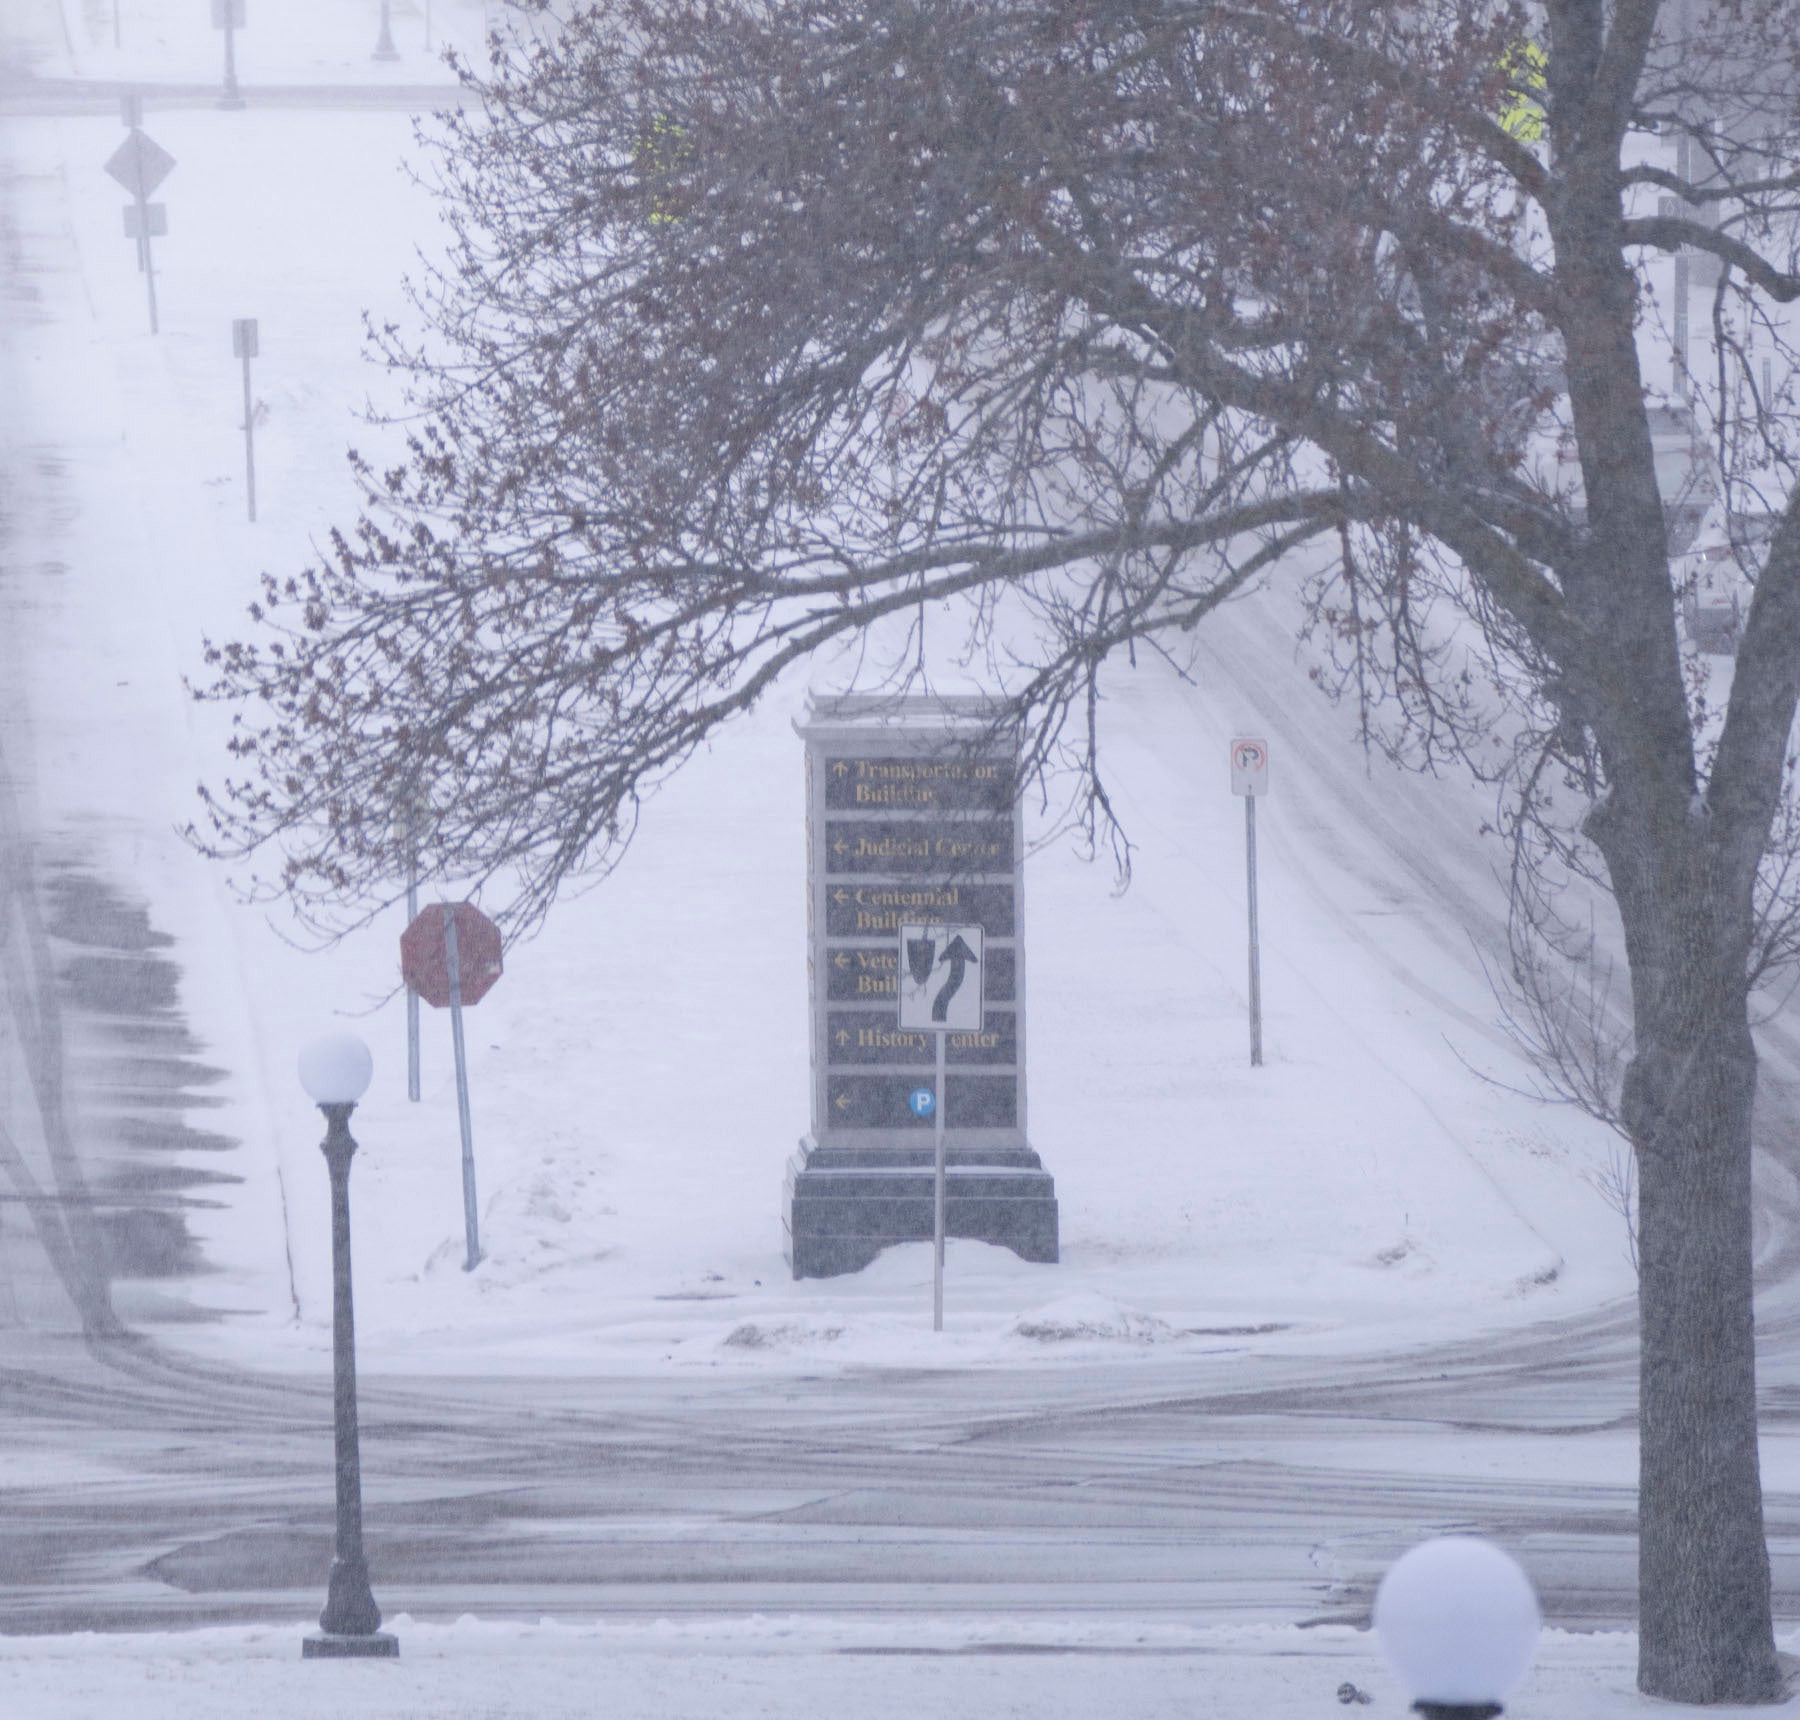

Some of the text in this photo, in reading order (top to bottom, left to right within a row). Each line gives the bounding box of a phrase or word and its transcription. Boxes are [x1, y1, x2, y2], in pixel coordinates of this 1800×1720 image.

[855, 760, 999, 782] Transportaon
[856, 783, 940, 803] Buildin
[855, 837, 1000, 856] Judicial Cener
[855, 887, 959, 905] Centennial
[856, 951, 897, 969] Vete
[857, 975, 897, 993] Buil
[857, 1028, 1000, 1048] History enter
[917, 1093, 930, 1111] P
